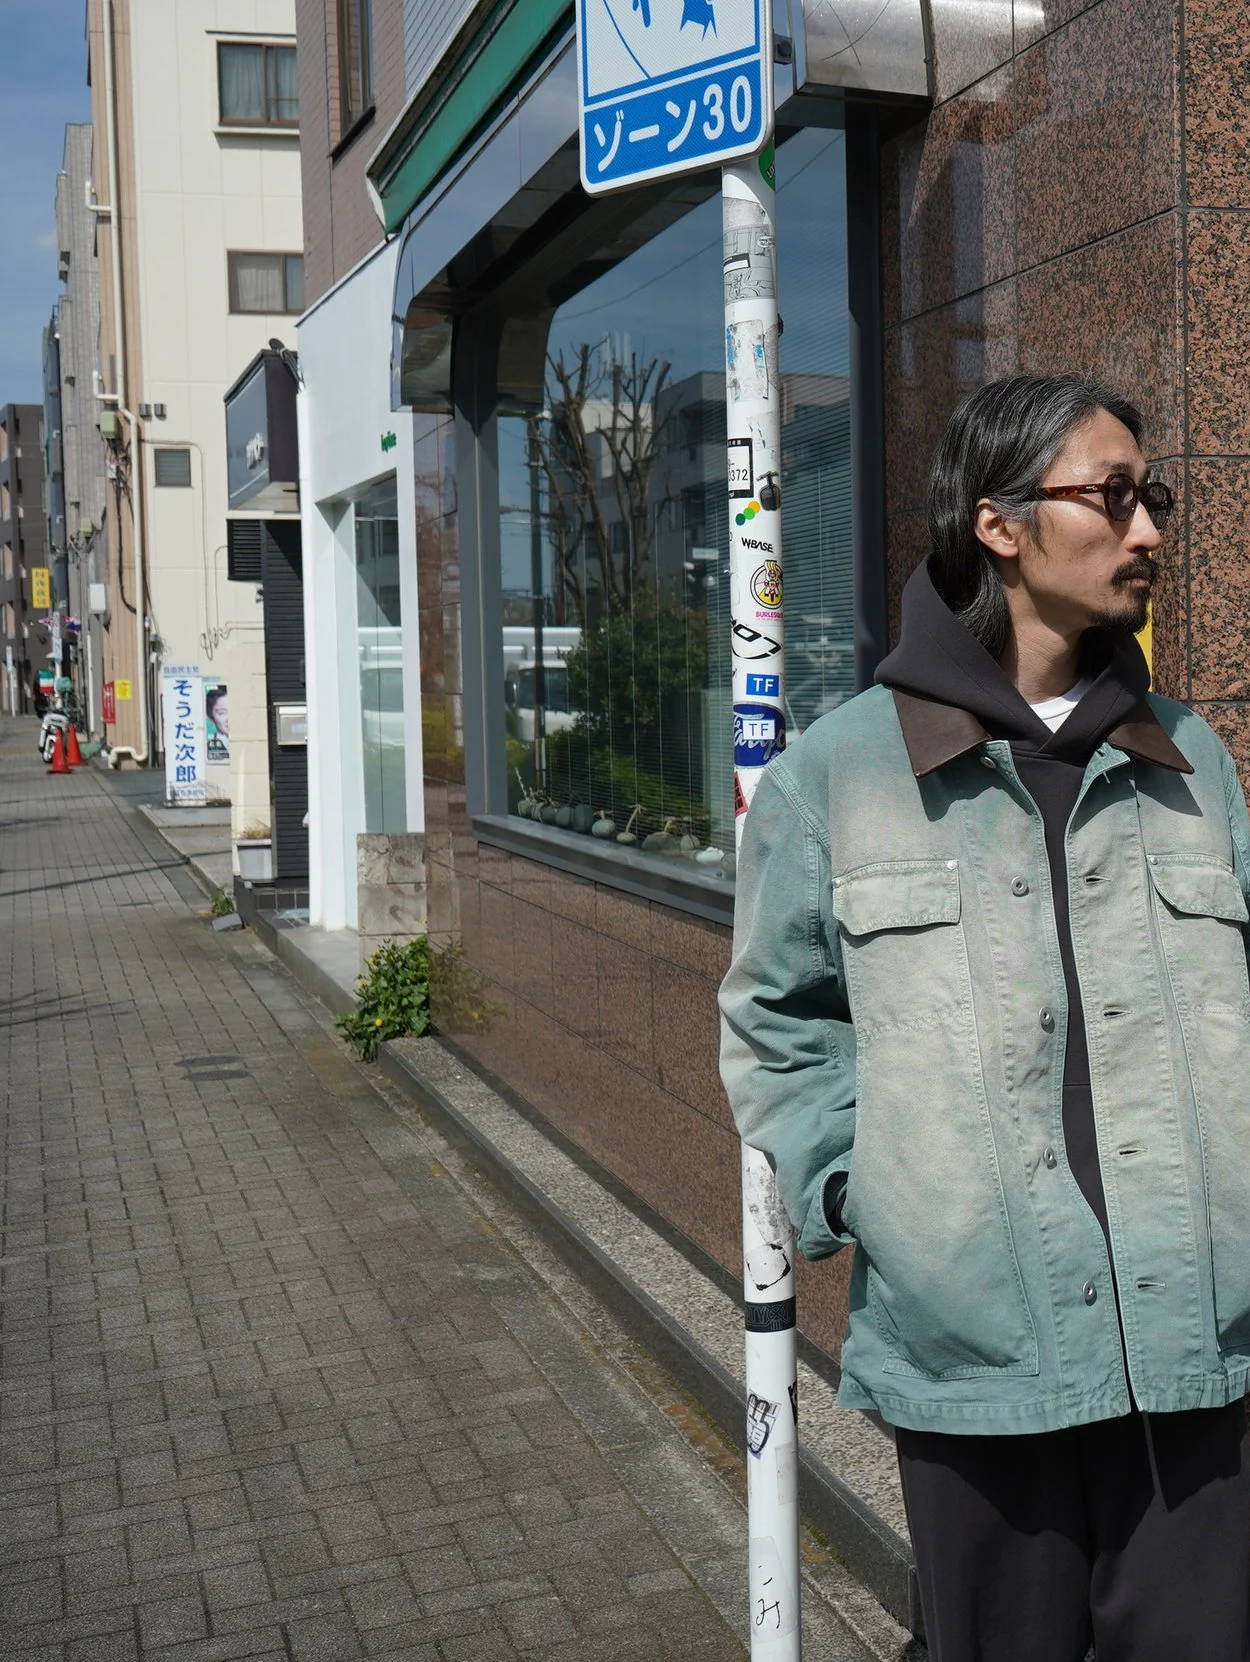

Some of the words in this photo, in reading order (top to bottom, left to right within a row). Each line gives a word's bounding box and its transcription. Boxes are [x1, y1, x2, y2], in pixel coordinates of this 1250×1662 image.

[593, 75, 753, 172] ゾーン30
[728, 469, 749, 482] 372
[752, 677, 774, 693] TF
[173, 679, 197, 784] そうだ次郎
[748, 723, 769, 737] TF
